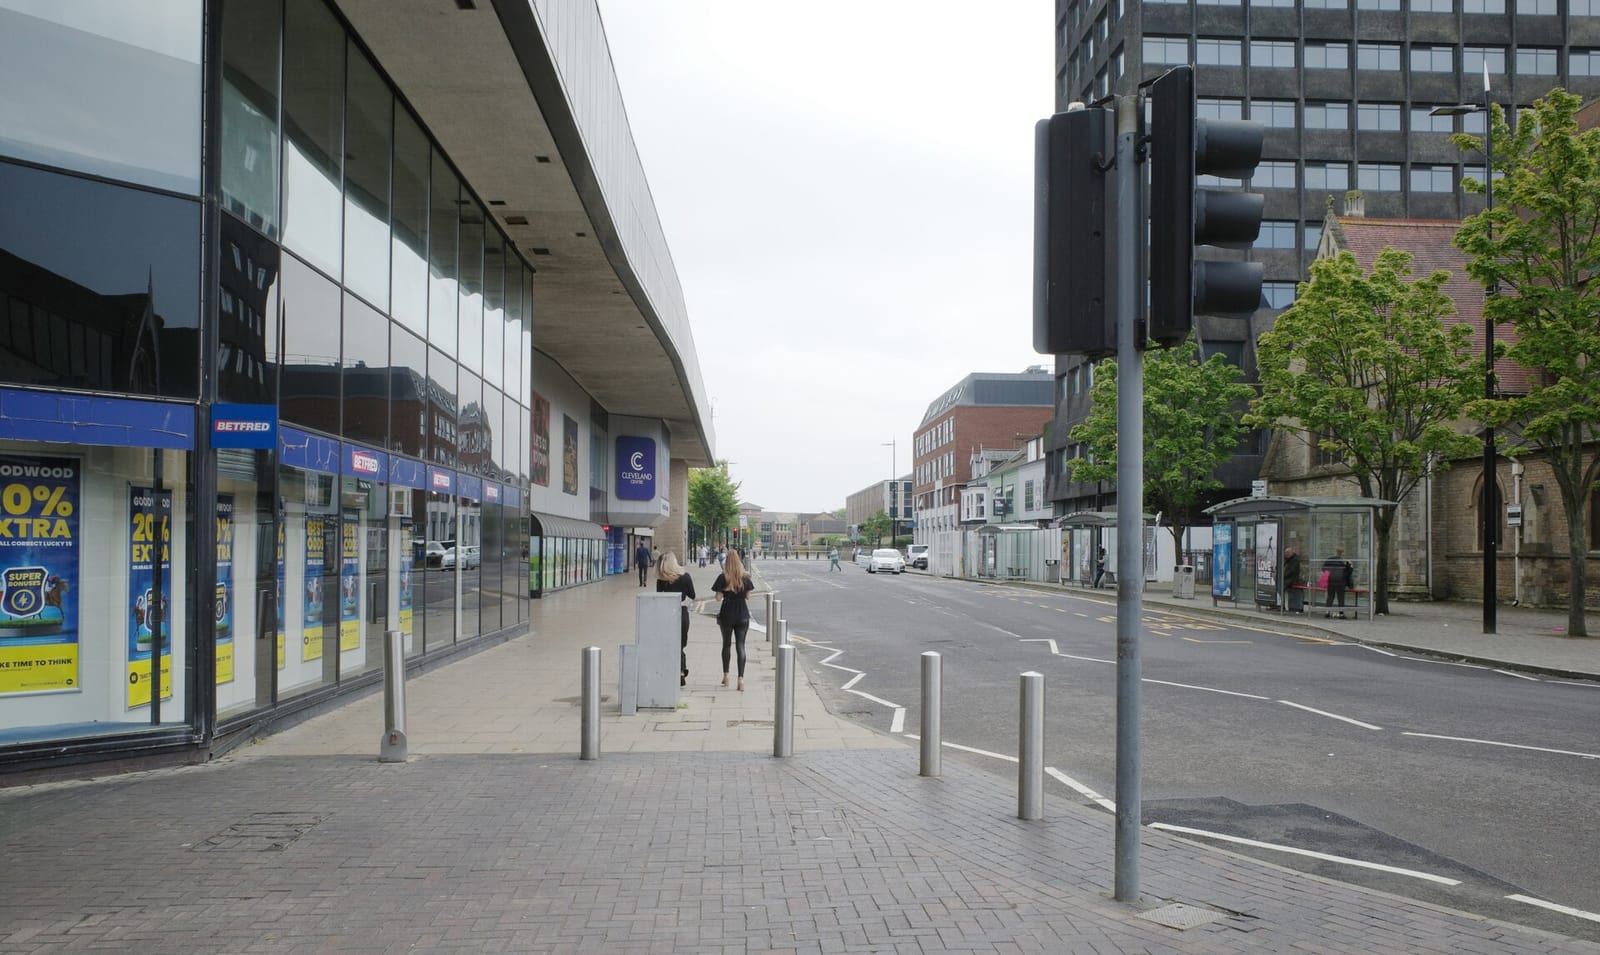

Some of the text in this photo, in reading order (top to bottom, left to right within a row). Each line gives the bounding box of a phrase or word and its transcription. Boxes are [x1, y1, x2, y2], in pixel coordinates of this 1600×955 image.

[217, 421, 270, 431] BETFRED
[354, 454, 378, 473] BETFRED
[621, 471, 653, 481] CLEVELAND
[9, 572, 41, 581] SUPER
[8, 580, 41, 588] BONUSES
[12, 660, 33, 668] TIME
